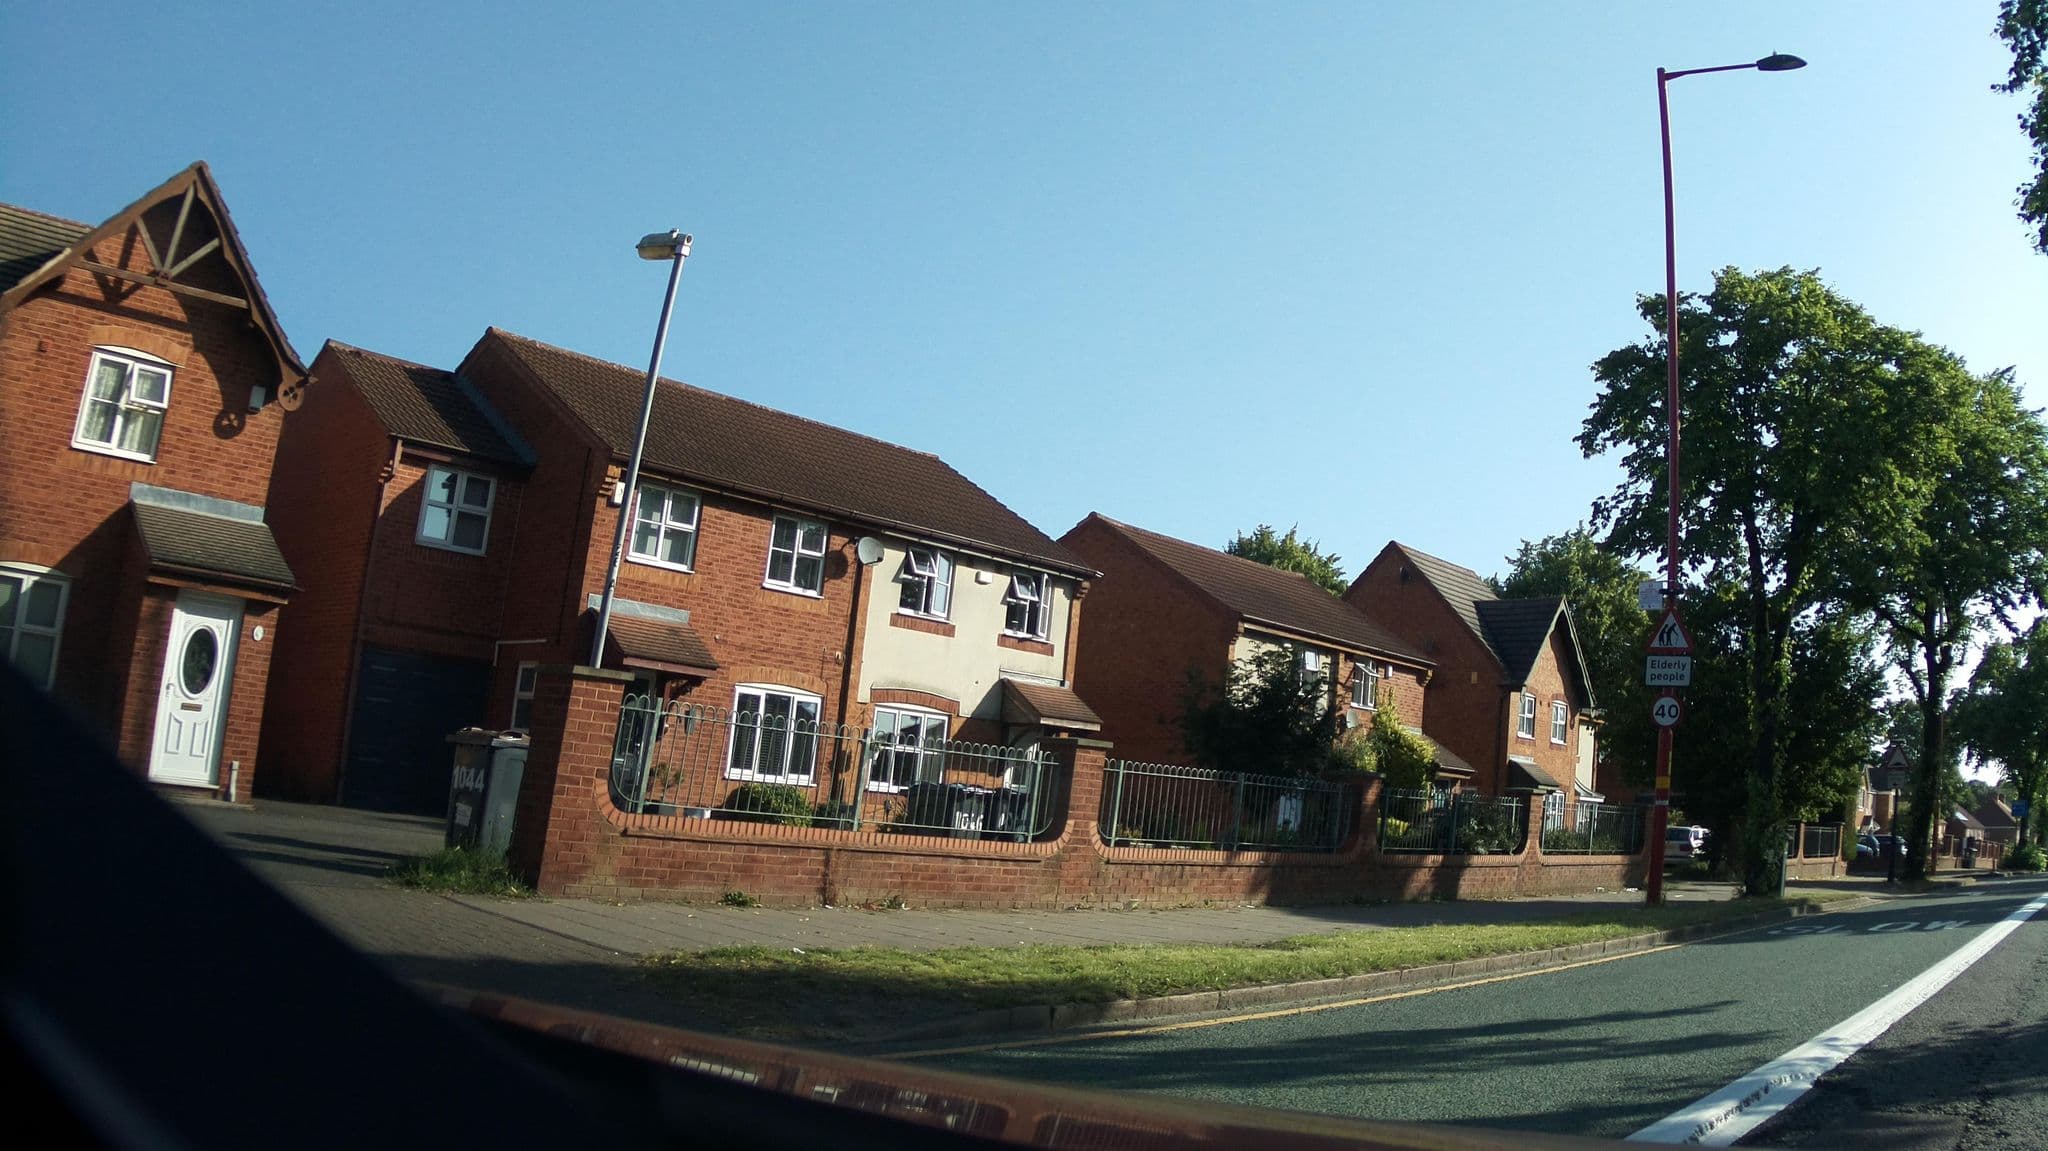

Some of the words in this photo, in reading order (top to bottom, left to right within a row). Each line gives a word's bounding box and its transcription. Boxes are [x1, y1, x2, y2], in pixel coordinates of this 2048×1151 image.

[1650, 660, 1687, 671] Elderly
[1650, 671, 1685, 683] people
[1655, 704, 1679, 719] 40
[453, 766, 484, 792] 1044
